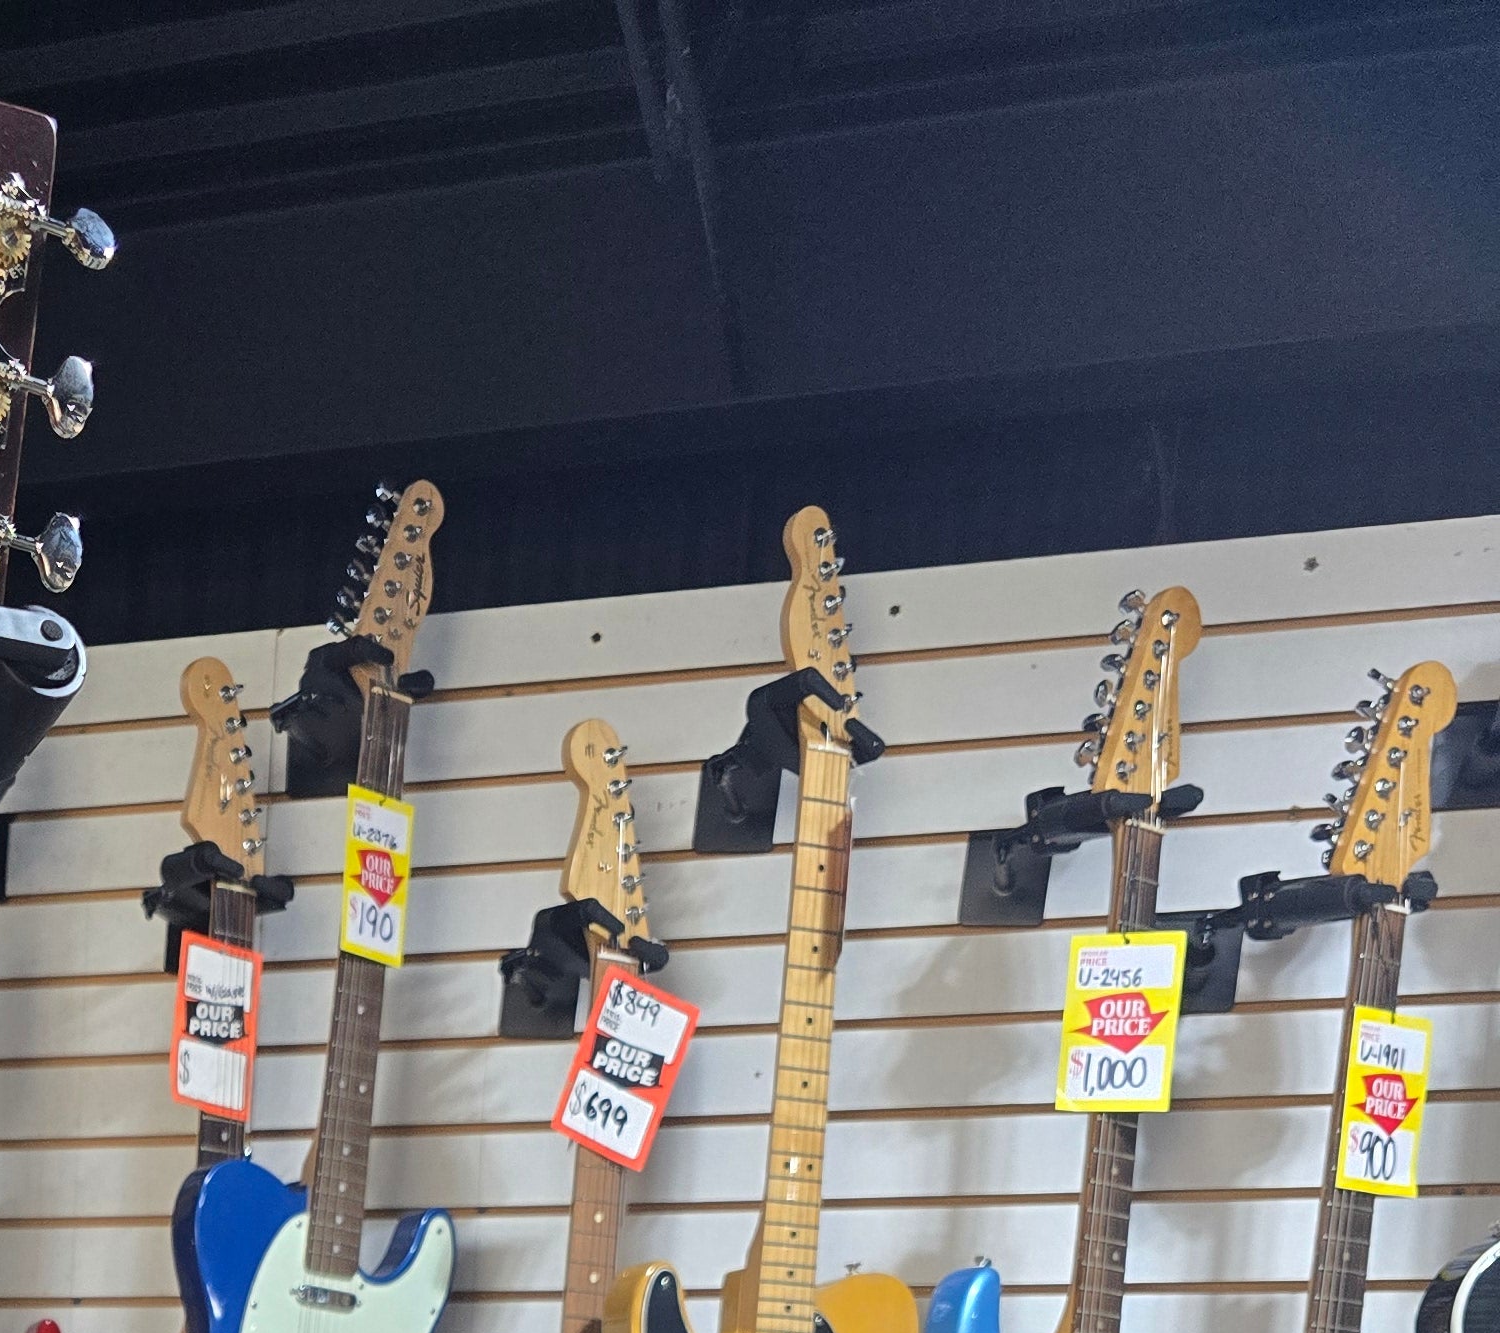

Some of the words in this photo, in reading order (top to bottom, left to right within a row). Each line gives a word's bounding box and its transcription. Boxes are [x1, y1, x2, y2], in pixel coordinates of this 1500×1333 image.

[365, 853, 392, 876] OUR
[360, 870, 395, 895] PRICE
[350, 896, 394, 942] $190
[1078, 967, 1143, 988] U-2456
[194, 1002, 236, 1022] OUR
[1099, 998, 1146, 1018] OUR
[188, 1019, 243, 1039] PRICE
[1090, 1017, 1152, 1037] PRICE
[605, 1038, 653, 1068] OUR
[592, 1056, 659, 1087] PRICE
[1371, 1076, 1405, 1100] OUR
[567, 1081, 628, 1138] $699
[1364, 1096, 1408, 1121] PRICE
